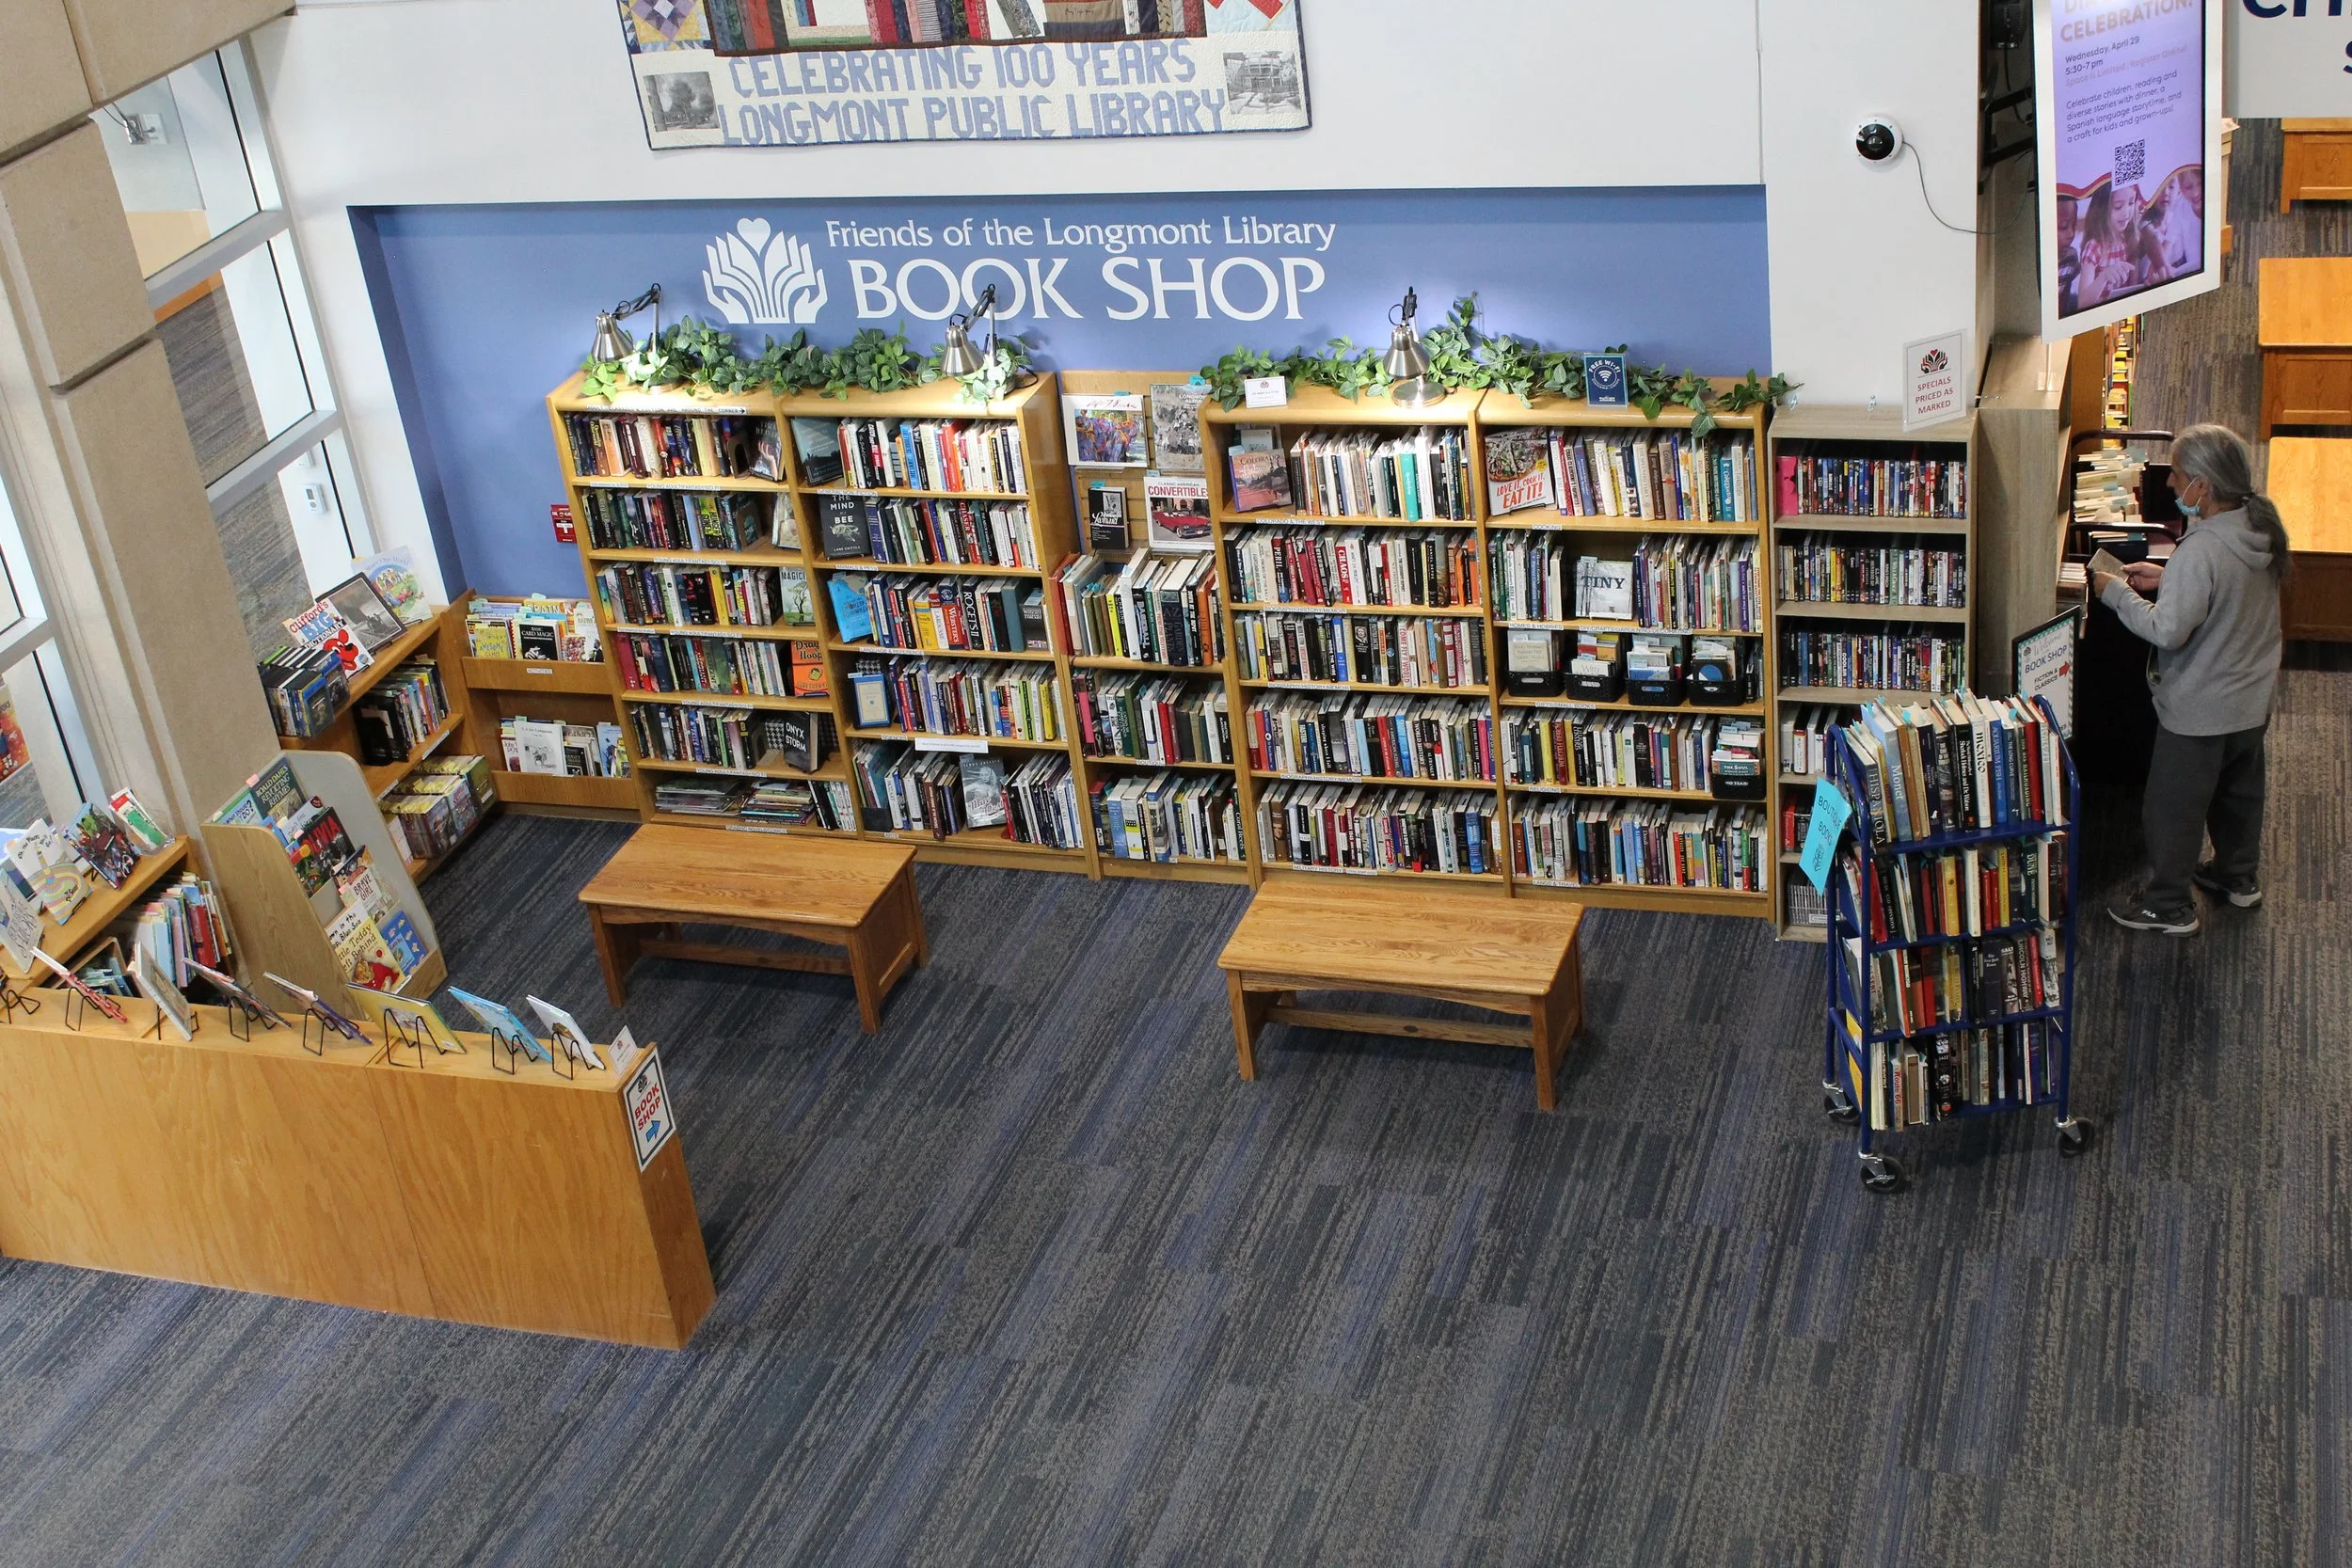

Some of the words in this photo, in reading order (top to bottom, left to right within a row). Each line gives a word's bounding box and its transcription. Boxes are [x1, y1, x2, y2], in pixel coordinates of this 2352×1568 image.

[2065, 45, 2109, 63] Wednesday,
[2111, 40, 2128, 54] April
[2130, 36, 2140, 44] 29
[728, 47, 982, 98] CELEBRATING
[994, 43, 1056, 89] 100
[1066, 38, 1196, 86] YEARS
[2091, 59, 2104, 70] pm
[2066, 93, 2102, 109] Celebrate
[2135, 75, 2162, 89] reading
[2163, 71, 2177, 81] and
[719, 97, 909, 145] LONGMONT
[926, 94, 1055, 140] PUBLIC
[1069, 88, 1226, 137] LIBRARY
[2066, 107, 2091, 120] diverse
[2093, 100, 2117, 113] stories
[2118, 95, 2134, 105] with
[2067, 118, 2095, 133] Spanish
[2096, 108, 2130, 123] language
[2168, 91, 2182, 103] and
[2074, 130, 2091, 141] craft
[2092, 126, 2103, 135] for
[2104, 120, 2118, 132] kids
[2119, 118, 2134, 127] and
[826, 220, 932, 247] Friends
[944, 217, 973, 245] of
[985, 218, 1033, 246] the
[1045, 217, 1212, 253] Longmont
[1224, 215, 1336, 251] Library
[848, 258, 1084, 321] BOOK
[1102, 256, 1326, 321] SHOP
[1589, 359, 1604, 372] FREE
[1915, 390, 1942, 404] PRICED
[1944, 388, 1953, 396] AS
[1917, 376, 1951, 391] SPECIALS
[1918, 400, 1950, 414] MARKED
[1497, 483, 1513, 497] LOVE
[1522, 474, 1537, 485] COOK
[1502, 488, 1523, 509] EAT
[1526, 483, 1543, 500] IT!
[603, 518, 612, 538] Bones
[834, 515, 854, 524] BEE
[960, 502, 971, 533] CHASER
[1273, 546, 1282, 568] PERIL
[1338, 549, 1349, 580] CHAOS
[781, 571, 807, 580] MAGICI
[1581, 576, 1626, 590] TINY
[1187, 591, 1196, 603] DOWN
[289, 601, 329, 633] Clifford's
[301, 610, 334, 642] BIG
[934, 610, 946, 641] LAROUSSE
[1136, 601, 1152, 649] BASEBALL
[305, 620, 345, 649] DICTIONARY
[2033, 632, 2062, 657] Welcome
[2025, 656, 2046, 673] BOOK
[2048, 645, 2067, 662] SHOP
[2034, 669, 2054, 684] FICTION
[2034, 675, 2058, 691] CLASSICS
[786, 722, 804, 739] ONYX
[1414, 722, 1422, 742] WORLD
[785, 736, 807, 752] STORM
[1417, 742, 1425, 765] HISTORY
[1993, 726, 2001, 765] AQUARIUM
[256, 779, 274, 798] ROALD
[262, 773, 290, 803] REVOLTING
[1891, 765, 1903, 800] Monet
[268, 784, 291, 809] RHYMES
[1234, 812, 1243, 831] Coral
[1818, 796, 1842, 830] BOUTIQUE
[302, 816, 340, 858] OLIVIA
[1236, 831, 1245, 850] Reefs
[1819, 821, 1833, 846] BOOKS
[1555, 838, 1564, 863] Amsterdam
[2026, 853, 2037, 875] DUNE
[354, 873, 372, 895] BRAVE
[360, 887, 373, 900] GIRL
[328, 930, 338, 941] own
[346, 912, 357, 923] the
[339, 929, 352, 942] Blue
[352, 919, 362, 930] Sea
[339, 948, 350, 960] ttle
[349, 924, 373, 948] Teddy
[342, 958, 353, 971] eft
[351, 934, 376, 961] Behind
[2017, 939, 2026, 969] LINCOLN
[2019, 970, 2029, 998] HIGHWAY
[1894, 1071, 1902, 1094] Route
[634, 1082, 660, 1119] BOOK
[1895, 1094, 1902, 1105] 66
[637, 1096, 661, 1131] SHOP
